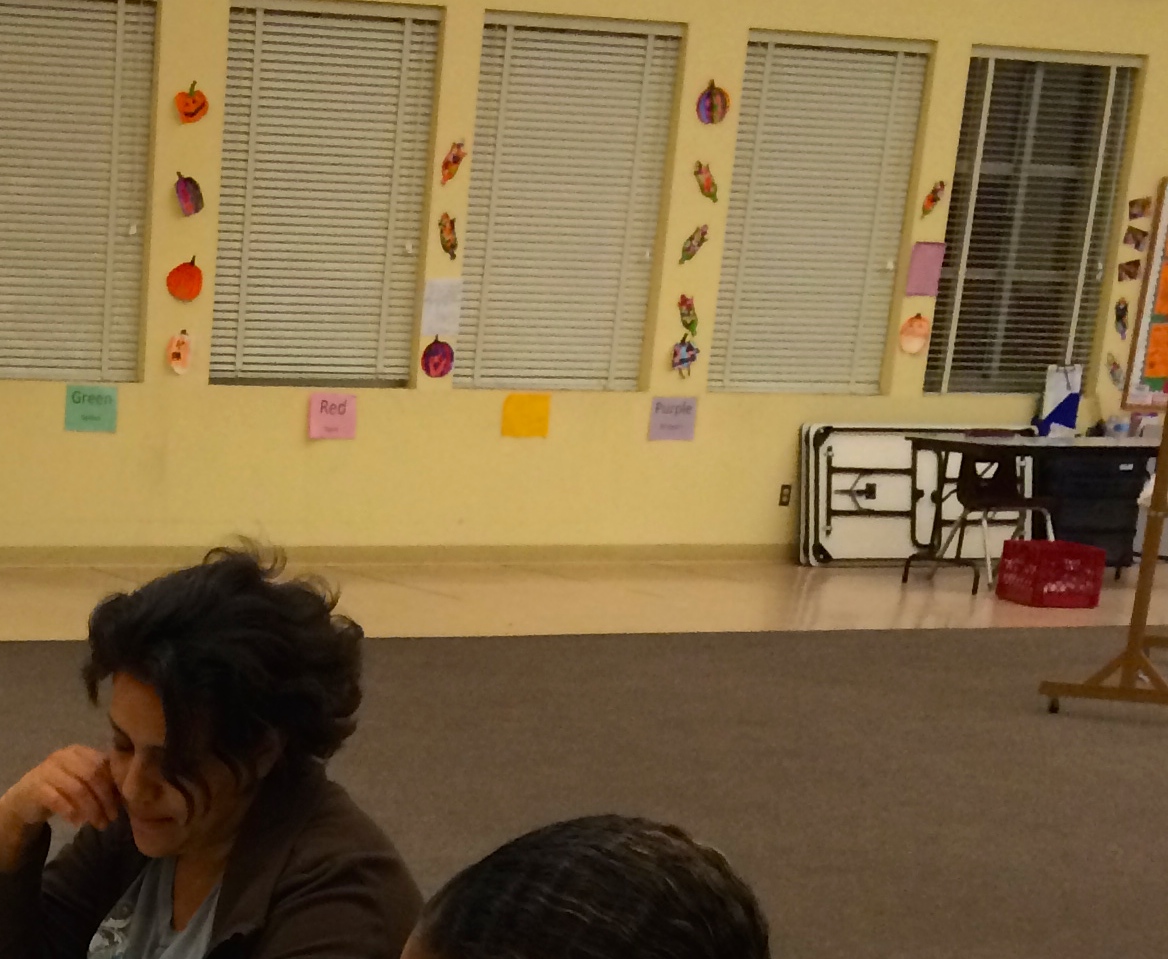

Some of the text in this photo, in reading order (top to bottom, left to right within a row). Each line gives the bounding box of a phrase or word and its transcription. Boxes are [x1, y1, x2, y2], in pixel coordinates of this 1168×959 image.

[71, 390, 112, 405] Green
[320, 399, 347, 415] Red
[655, 401, 693, 416] Purple
